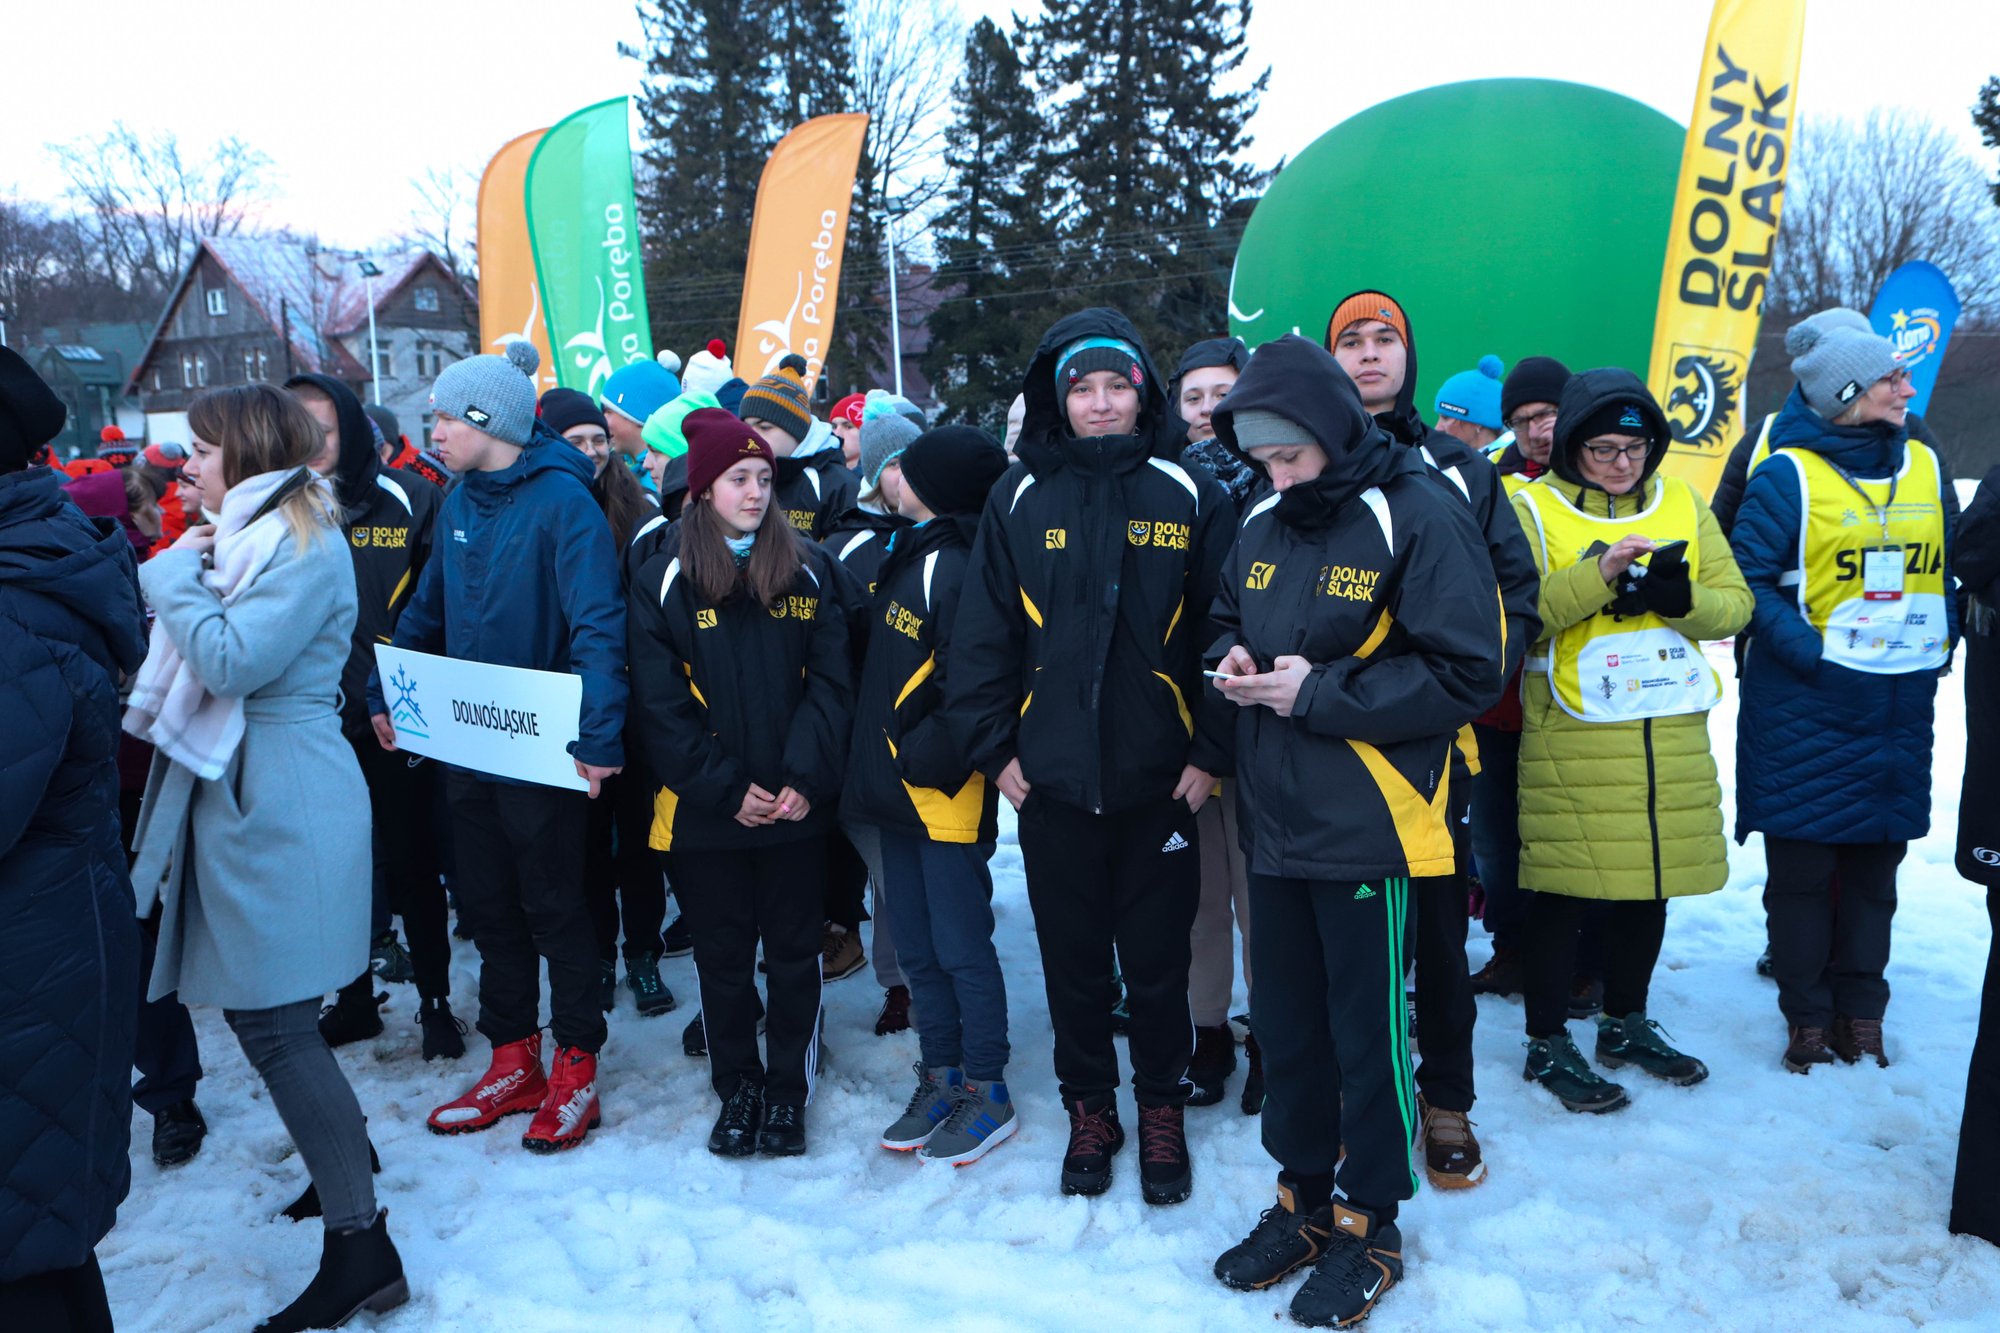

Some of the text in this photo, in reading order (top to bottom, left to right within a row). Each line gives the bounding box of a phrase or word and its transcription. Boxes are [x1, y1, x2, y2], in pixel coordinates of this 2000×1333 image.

[1678, 42, 1749, 308] DOLNY
[601, 202, 635, 322] Poręba
[801, 208, 837, 325] Poręba
[467, 410, 489, 422] 4F
[789, 509, 816, 521] DOLNY
[372, 526, 409, 539] DOLNY
[1154, 521, 1191, 537] DOLN
[1835, 542, 1942, 582] SZIA
[1330, 565, 1380, 587] DOLNY
[1326, 578, 1375, 602] ŚLĄSK
[788, 595, 819, 609] DLNY
[897, 606, 924, 630] DOLNY
[452, 699, 541, 739] DOLNOŚLĄSKIE
[1161, 840, 1189, 852] adidas
[1354, 890, 1377, 900] adidas
[476, 1068, 525, 1100] alpina
